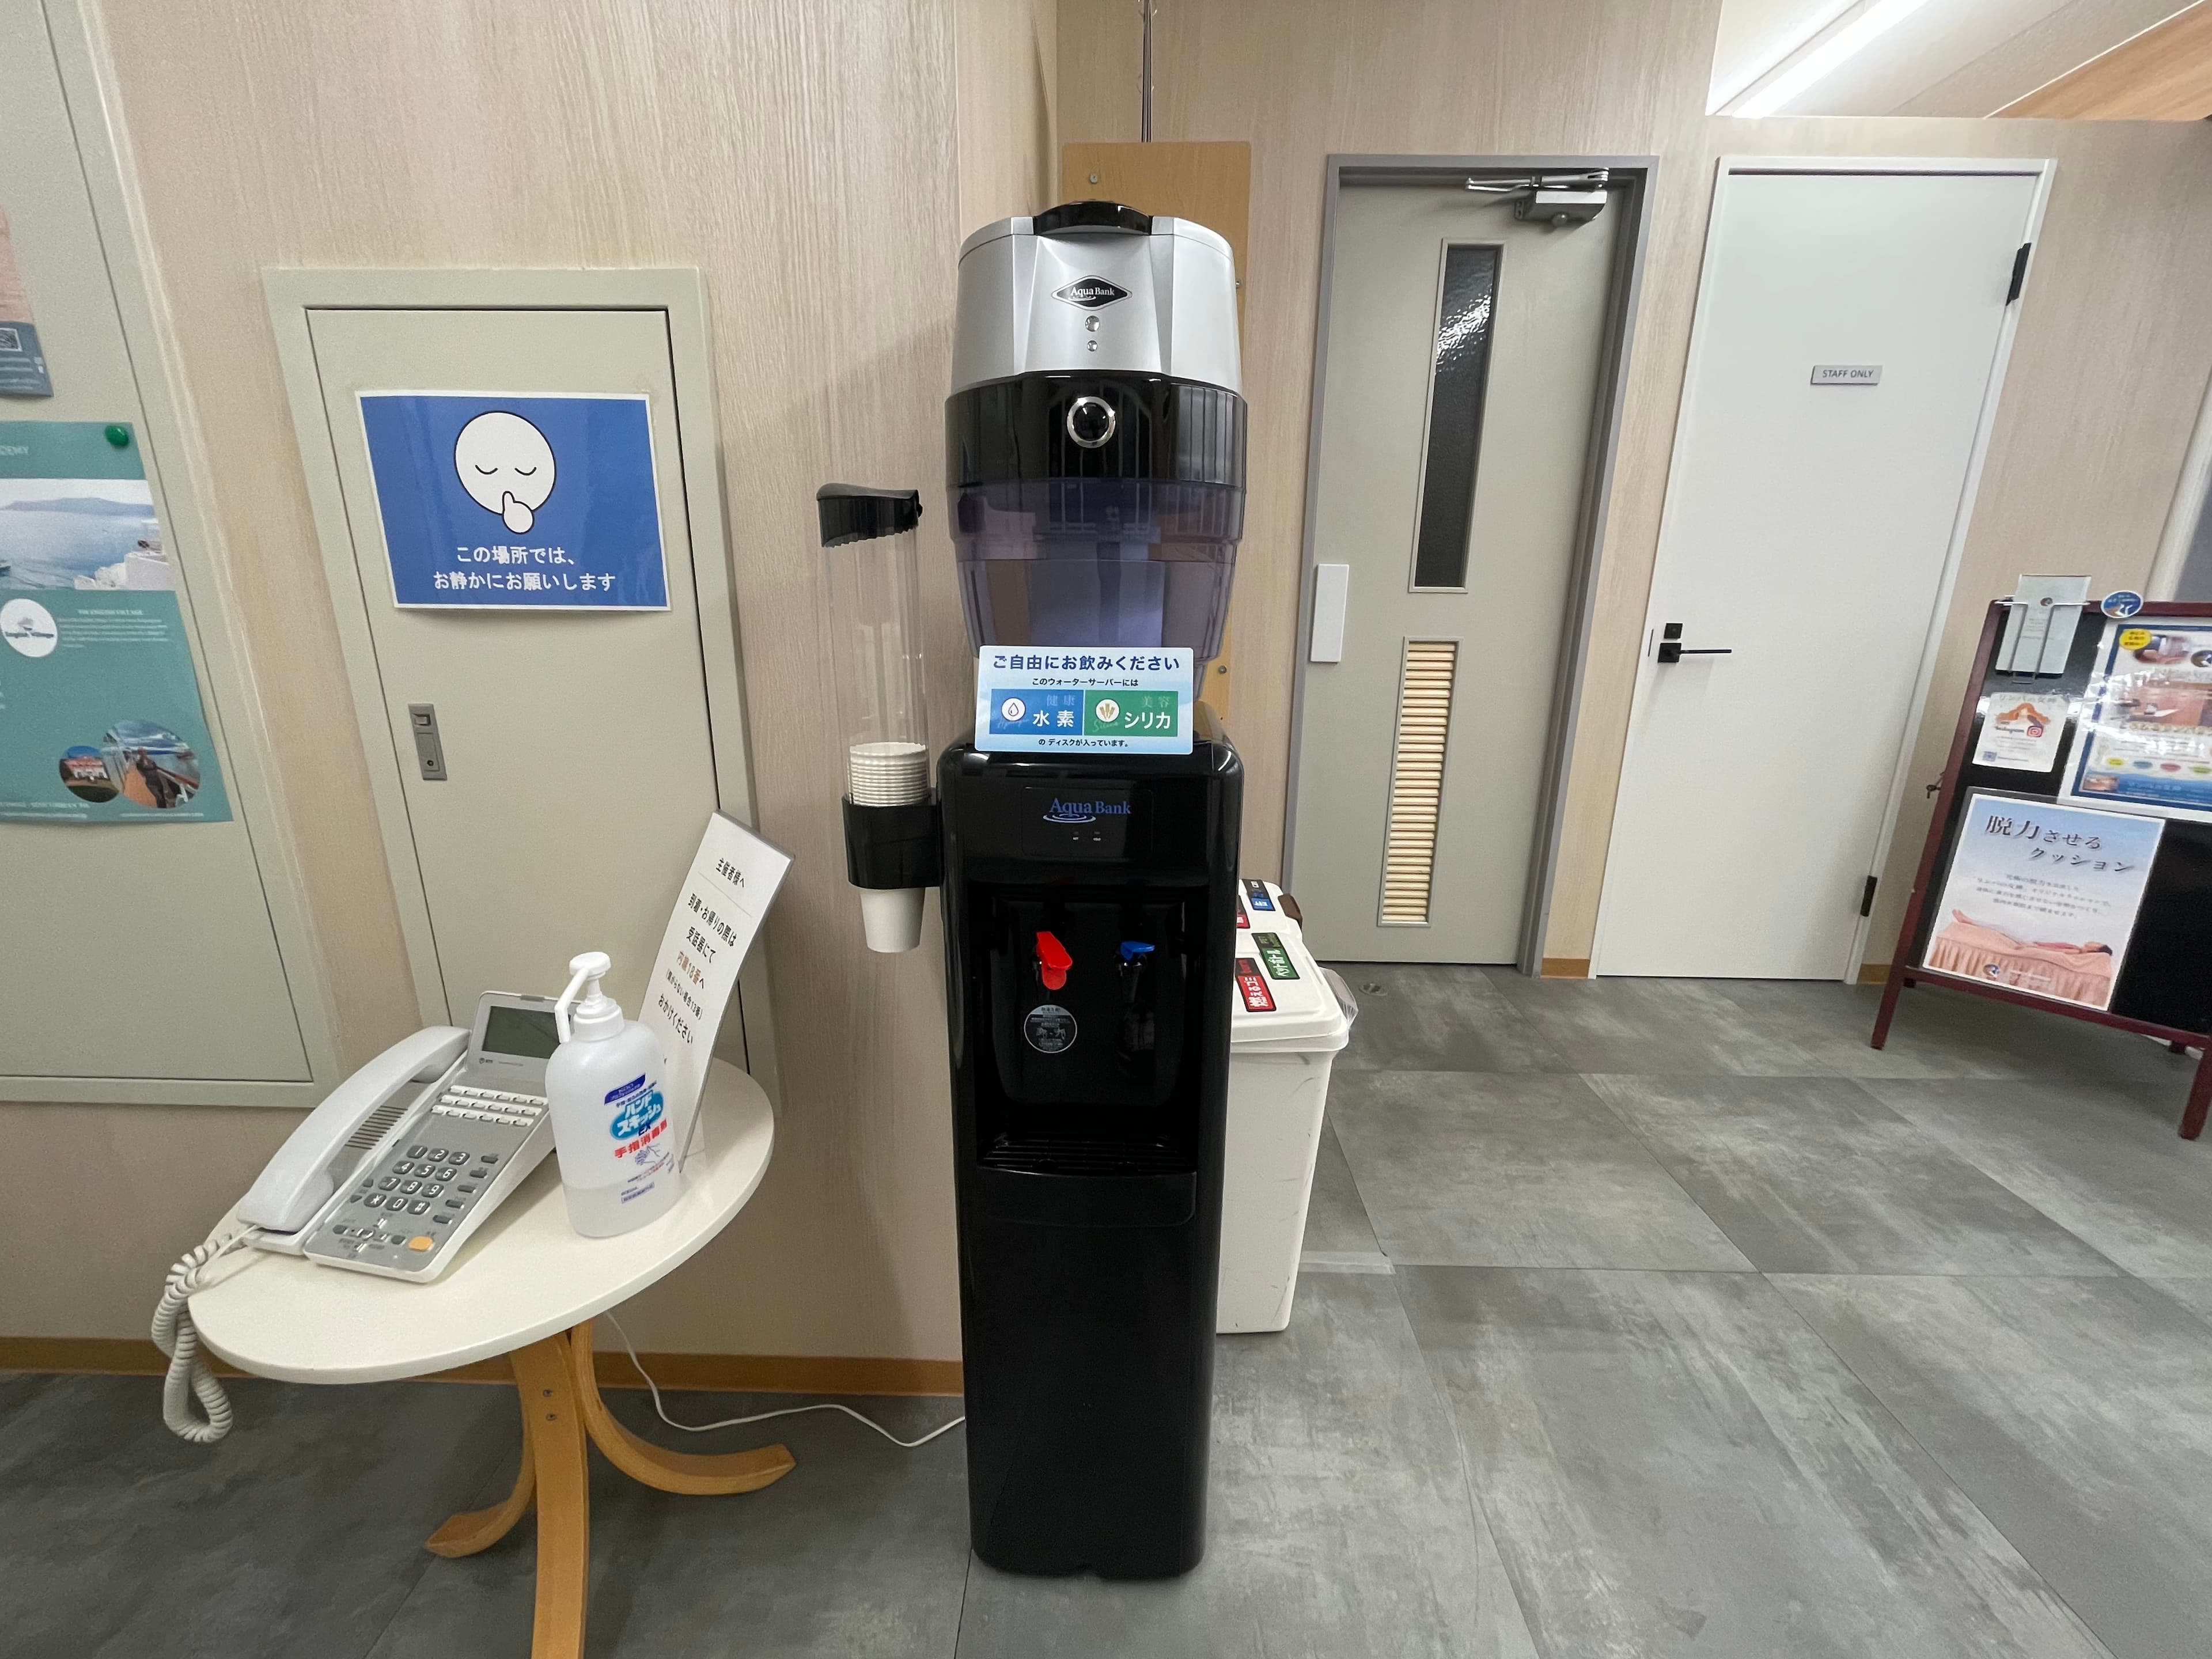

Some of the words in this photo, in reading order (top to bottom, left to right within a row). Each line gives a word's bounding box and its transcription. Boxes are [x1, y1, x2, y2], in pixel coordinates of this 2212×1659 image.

[1070, 286, 1094, 297] Aqua
[1094, 287, 1115, 296] Bank
[1822, 369, 1848, 378] STAFF
[1850, 369, 1874, 378] ONLY
[457, 546, 575, 565] この場所では、
[433, 571, 616, 592] お静かにお願いします
[993, 655, 1180, 671] ご自由にお飲みください
[1032, 677, 1139, 687] このウォーターサーバーには
[1124, 711, 1171, 729] シリカ
[1049, 798, 1092, 816] Aqua
[1095, 801, 1132, 814] Bank
[1985, 815, 2102, 850] 脱力させる
[2029, 847, 2135, 873] クッション
[686, 926, 716, 963] 受話器にて
[658, 993, 693, 1044] おかけください
[415, 1146, 423, 1156] 1
[435, 1150, 445, 1159] 2
[456, 1153, 466, 1162] 3
[401, 1162, 410, 1172] 4
[421, 1165, 432, 1175] 5
[442, 1169, 453, 1178] 6
[386, 1178, 396, 1187] 7
[407, 1181, 418, 1191] 8
[429, 1185, 440, 1195] 9
